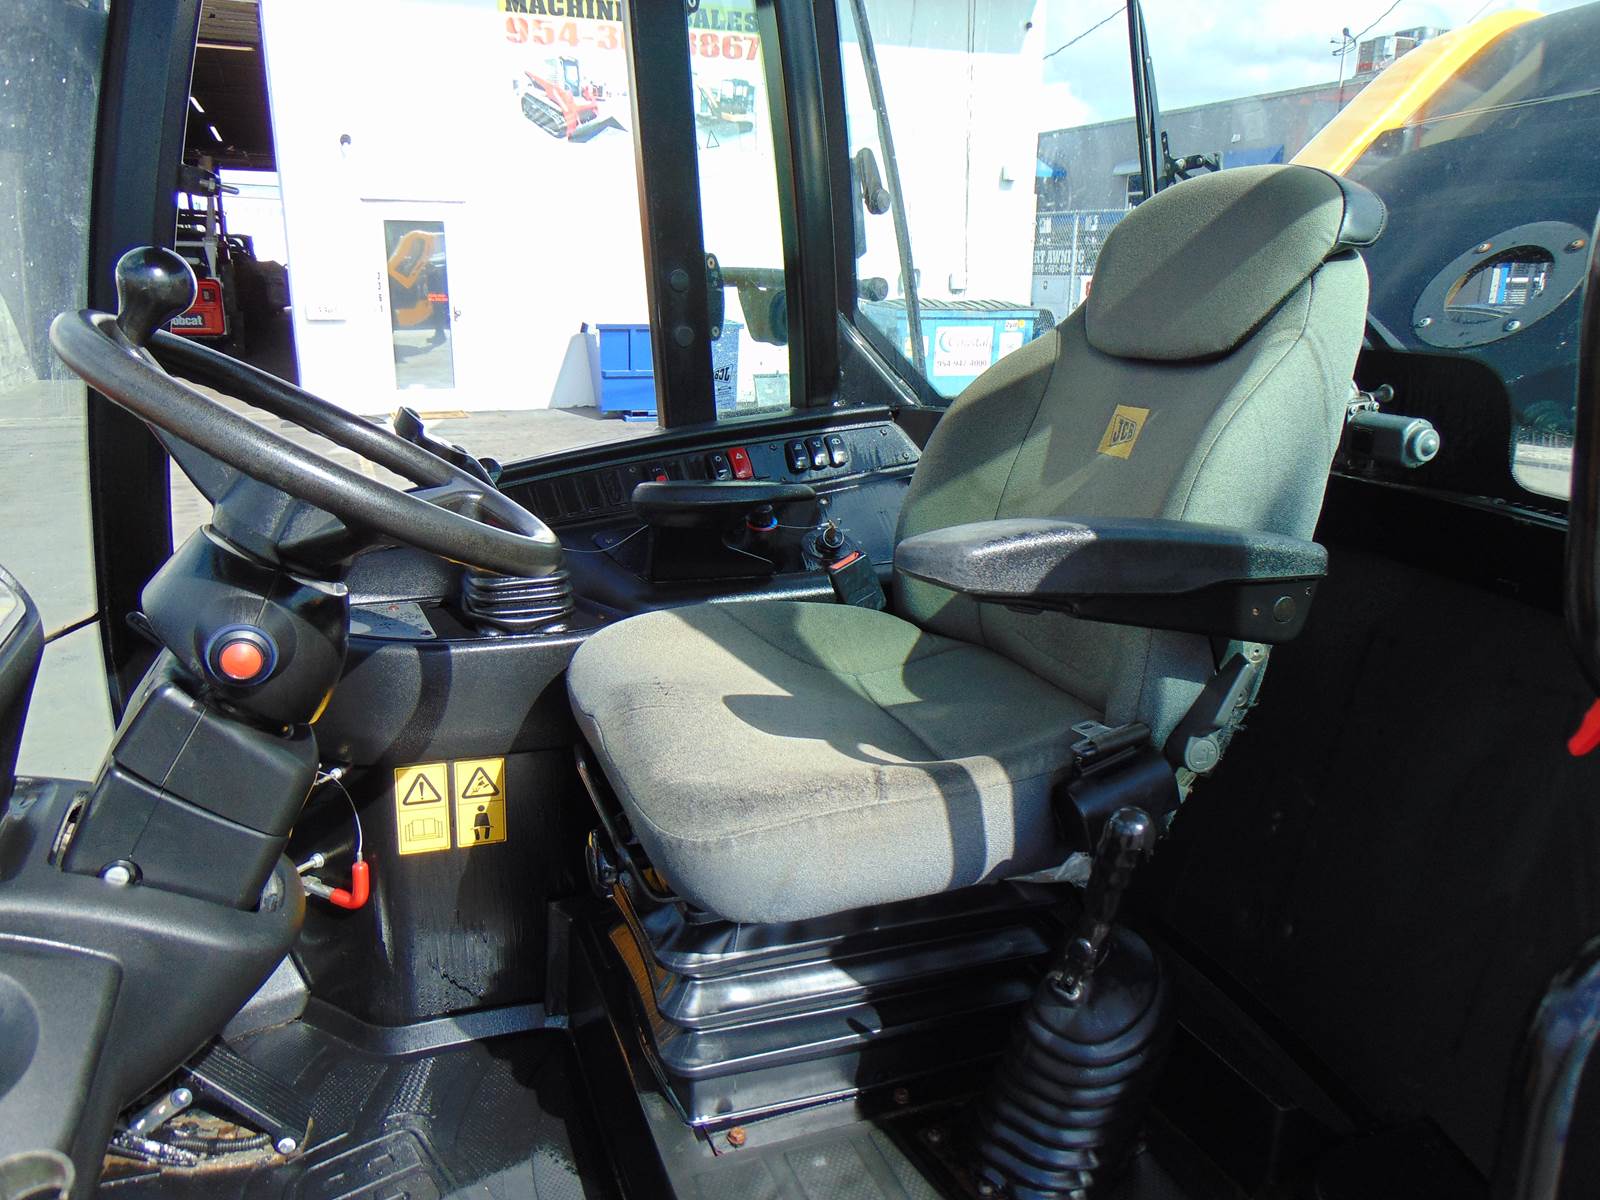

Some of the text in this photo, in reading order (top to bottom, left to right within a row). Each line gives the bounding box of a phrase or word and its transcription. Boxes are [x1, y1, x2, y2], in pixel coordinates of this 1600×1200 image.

[505, 0, 759, 32] MACHIN ALES
[505, 17, 626, 50] 954-3
[172, 315, 203, 326] obcat
